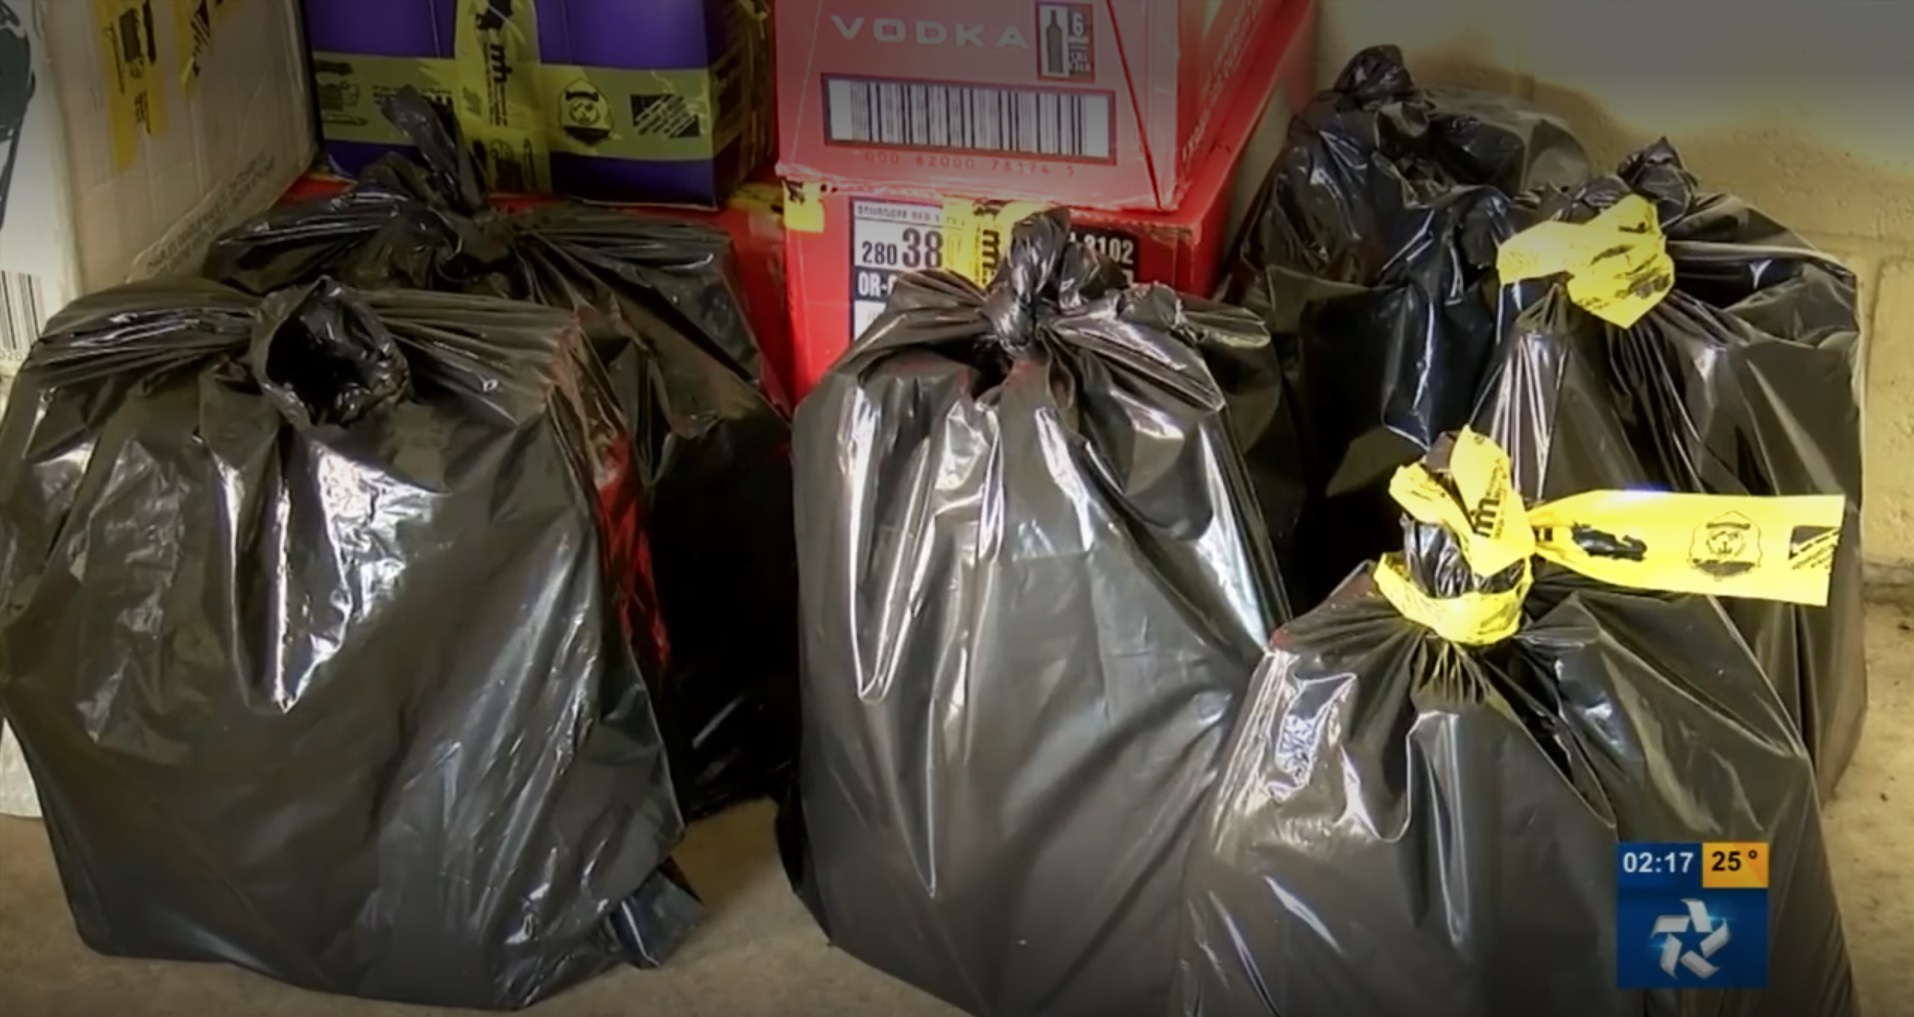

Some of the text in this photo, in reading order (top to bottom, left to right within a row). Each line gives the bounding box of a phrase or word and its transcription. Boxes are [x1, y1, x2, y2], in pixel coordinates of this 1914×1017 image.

[831, 15, 1029, 50] VODKA
[1072, 12, 1084, 36] 6
[862, 241, 898, 265] 280
